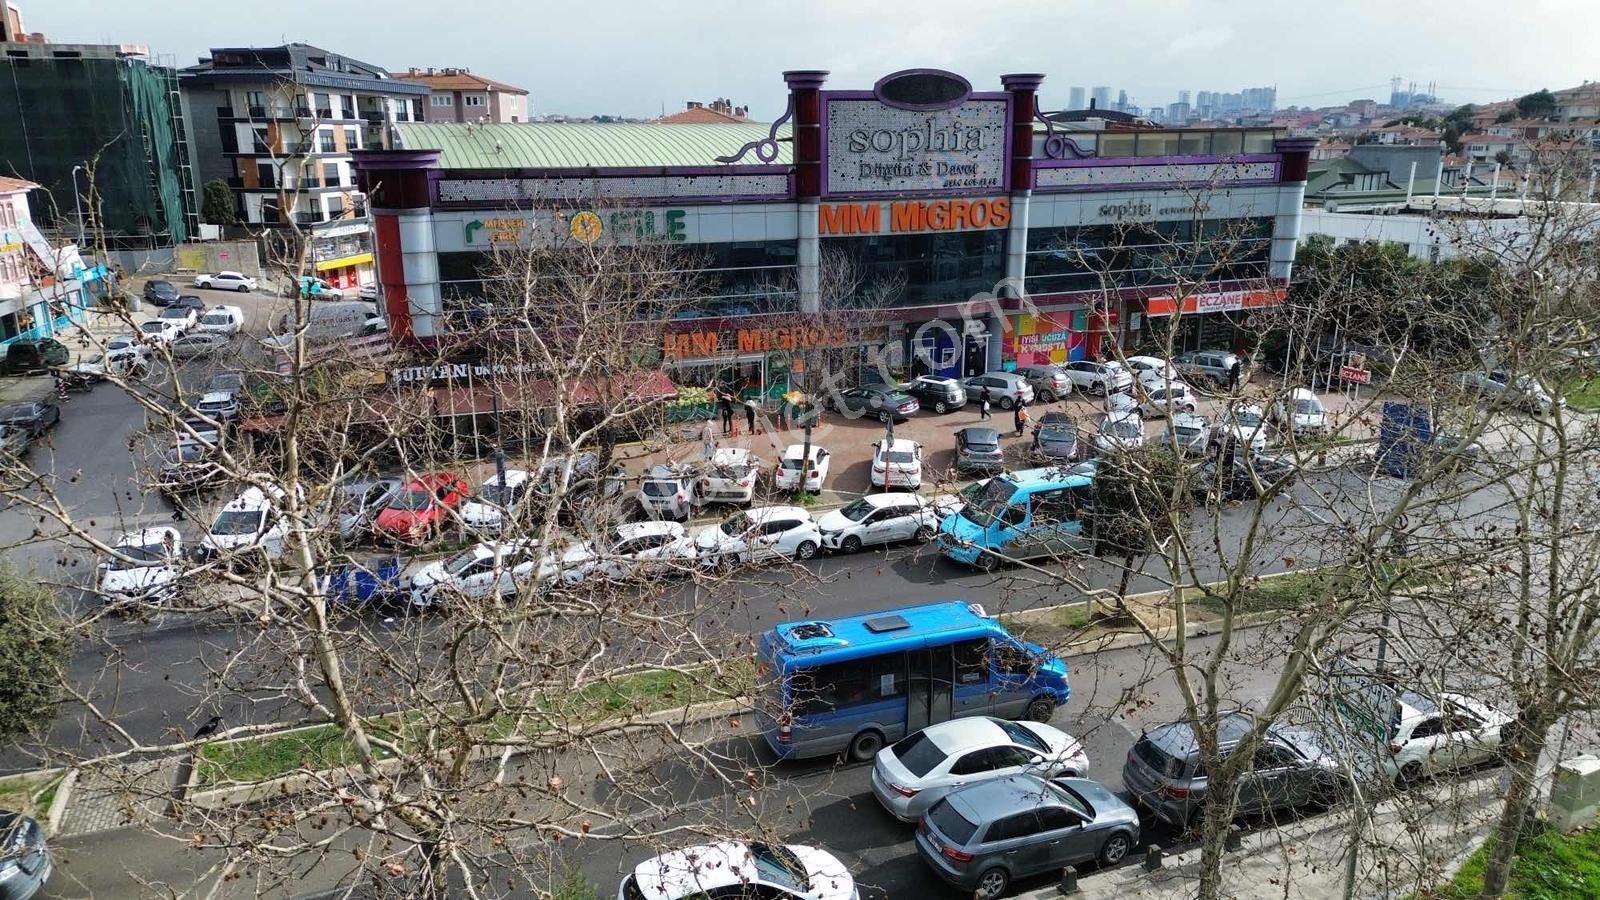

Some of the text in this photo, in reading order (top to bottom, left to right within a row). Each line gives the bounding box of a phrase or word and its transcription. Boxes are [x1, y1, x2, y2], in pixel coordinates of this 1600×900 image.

[850, 116, 986, 161] sophia
[918, 161, 932, 176] &
[819, 203, 881, 235] MM
[1200, 293, 1242, 308] ECZANE
